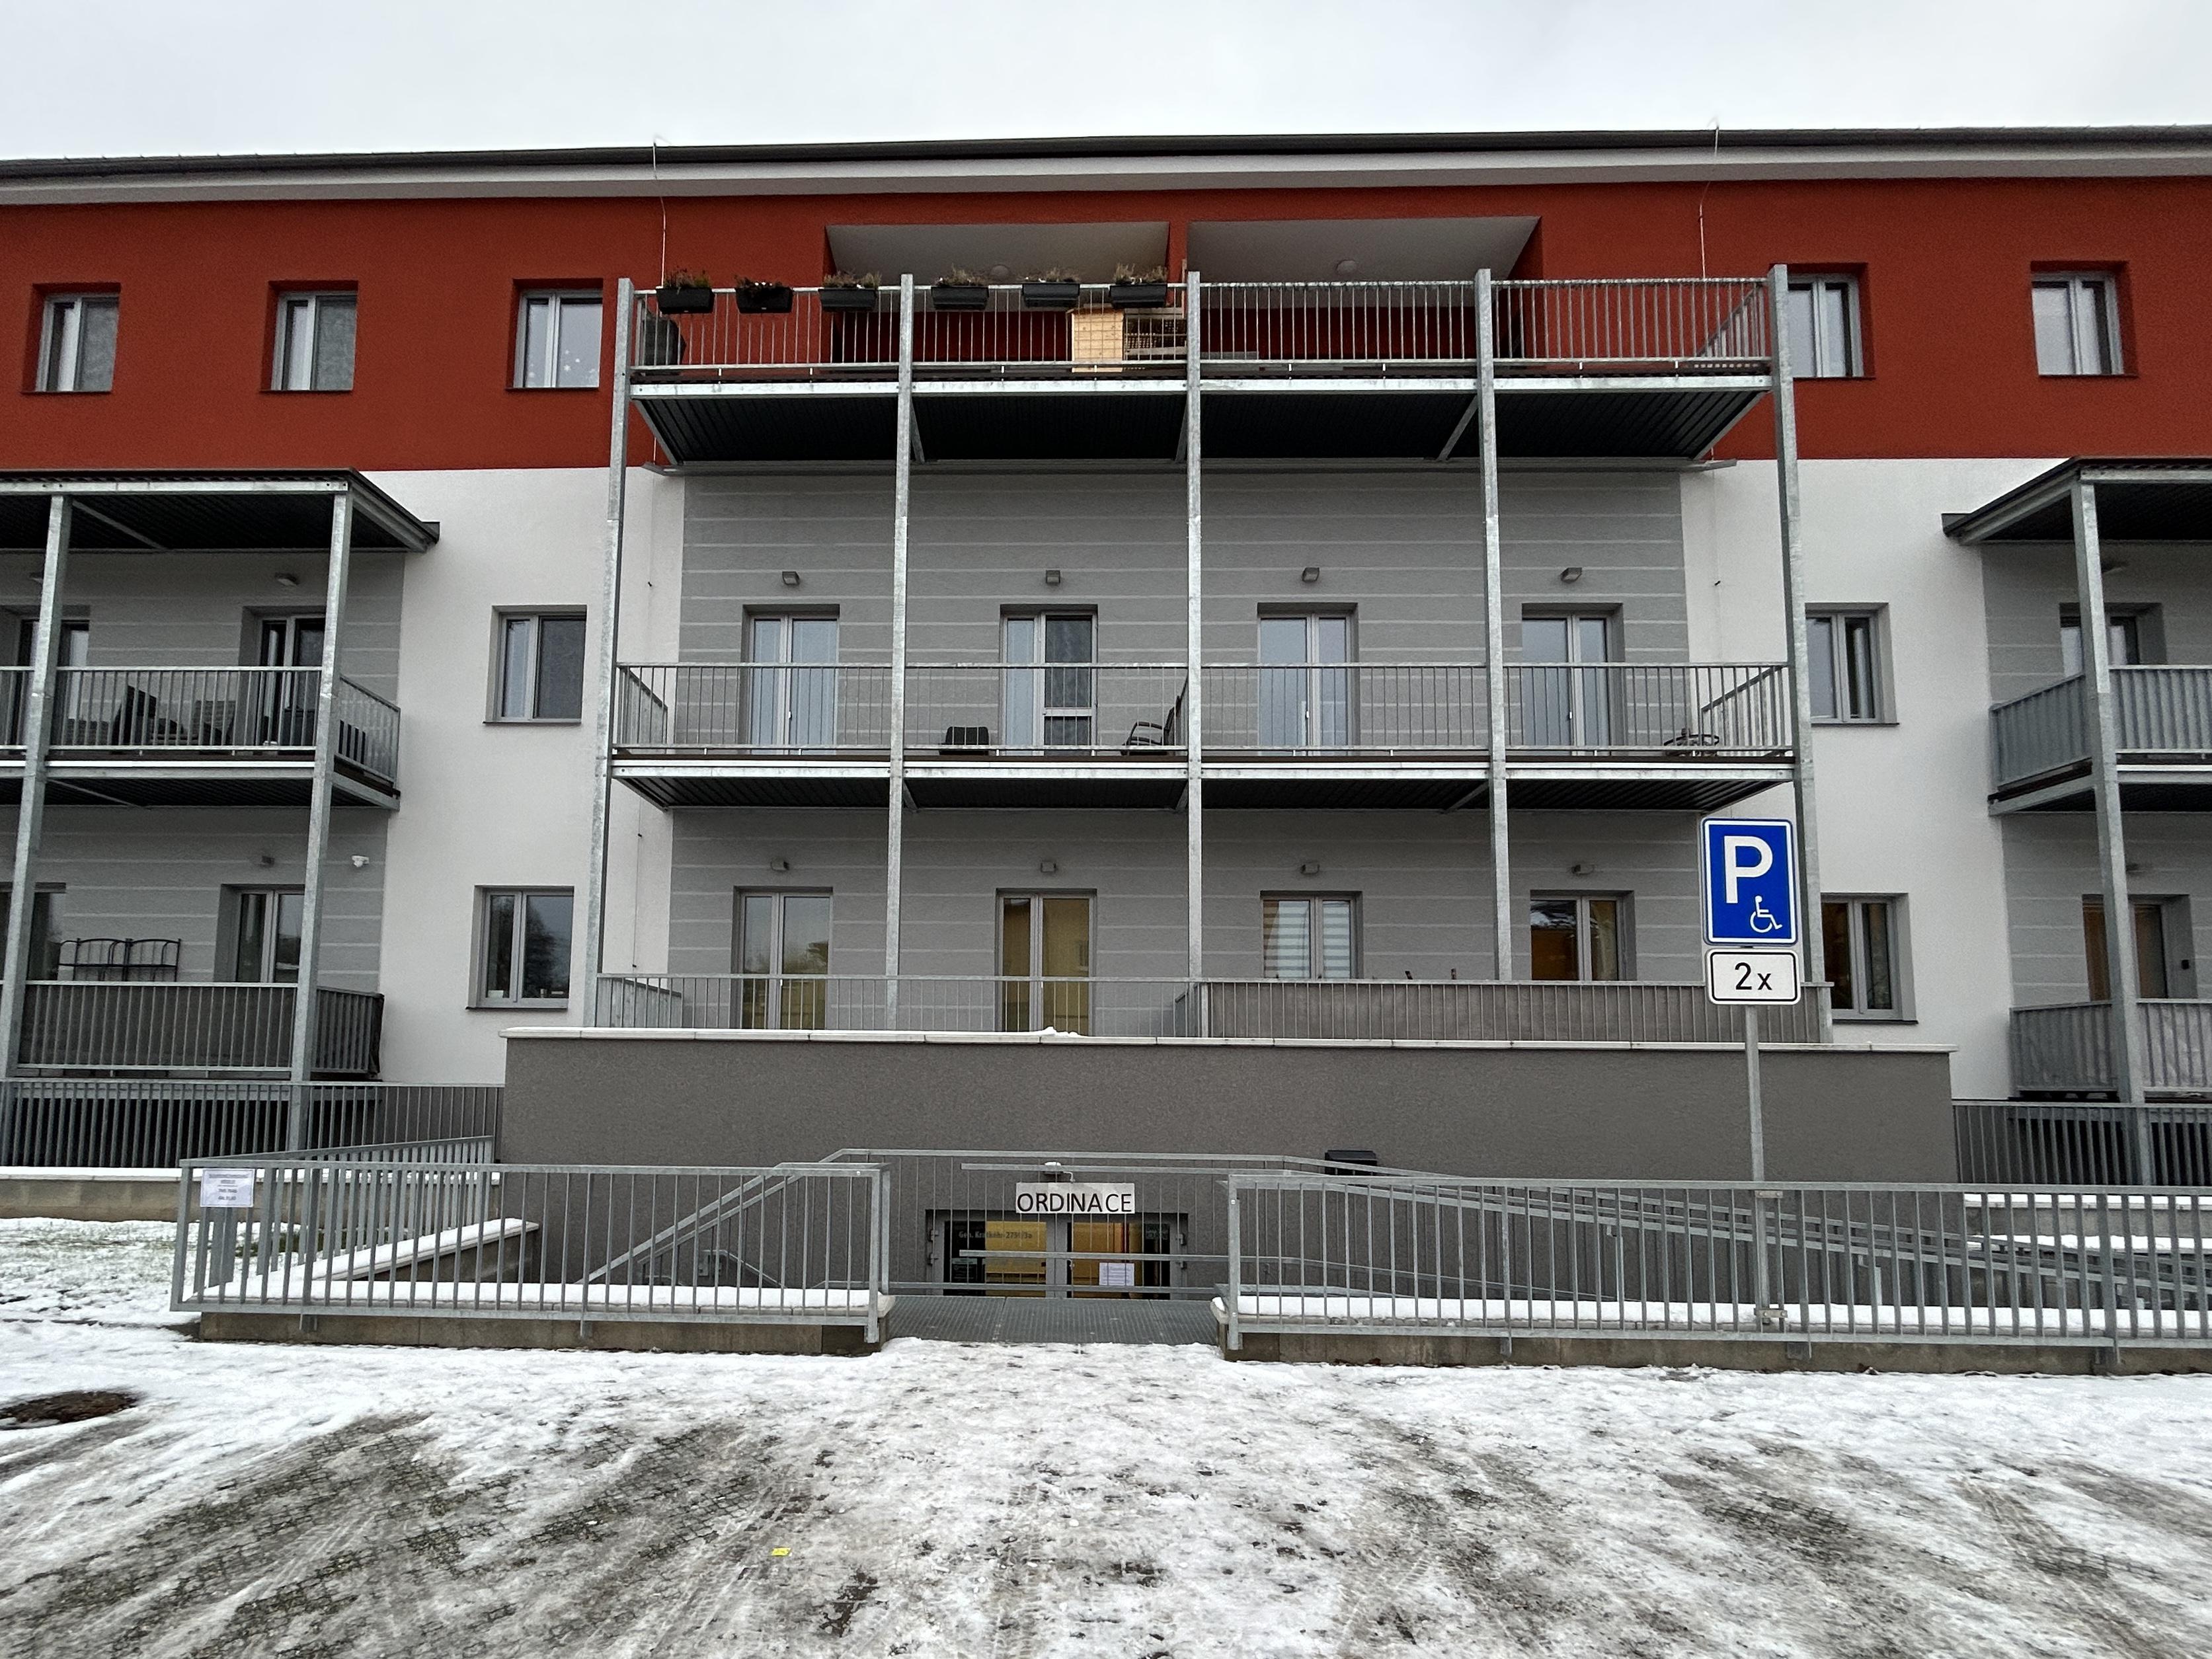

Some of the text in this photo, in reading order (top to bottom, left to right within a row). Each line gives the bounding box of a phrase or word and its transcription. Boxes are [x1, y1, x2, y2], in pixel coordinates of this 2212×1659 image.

[1723, 835, 1773, 904] P
[1735, 962, 1772, 990] 2x
[1017, 1193, 1132, 1212] ORDINACE
